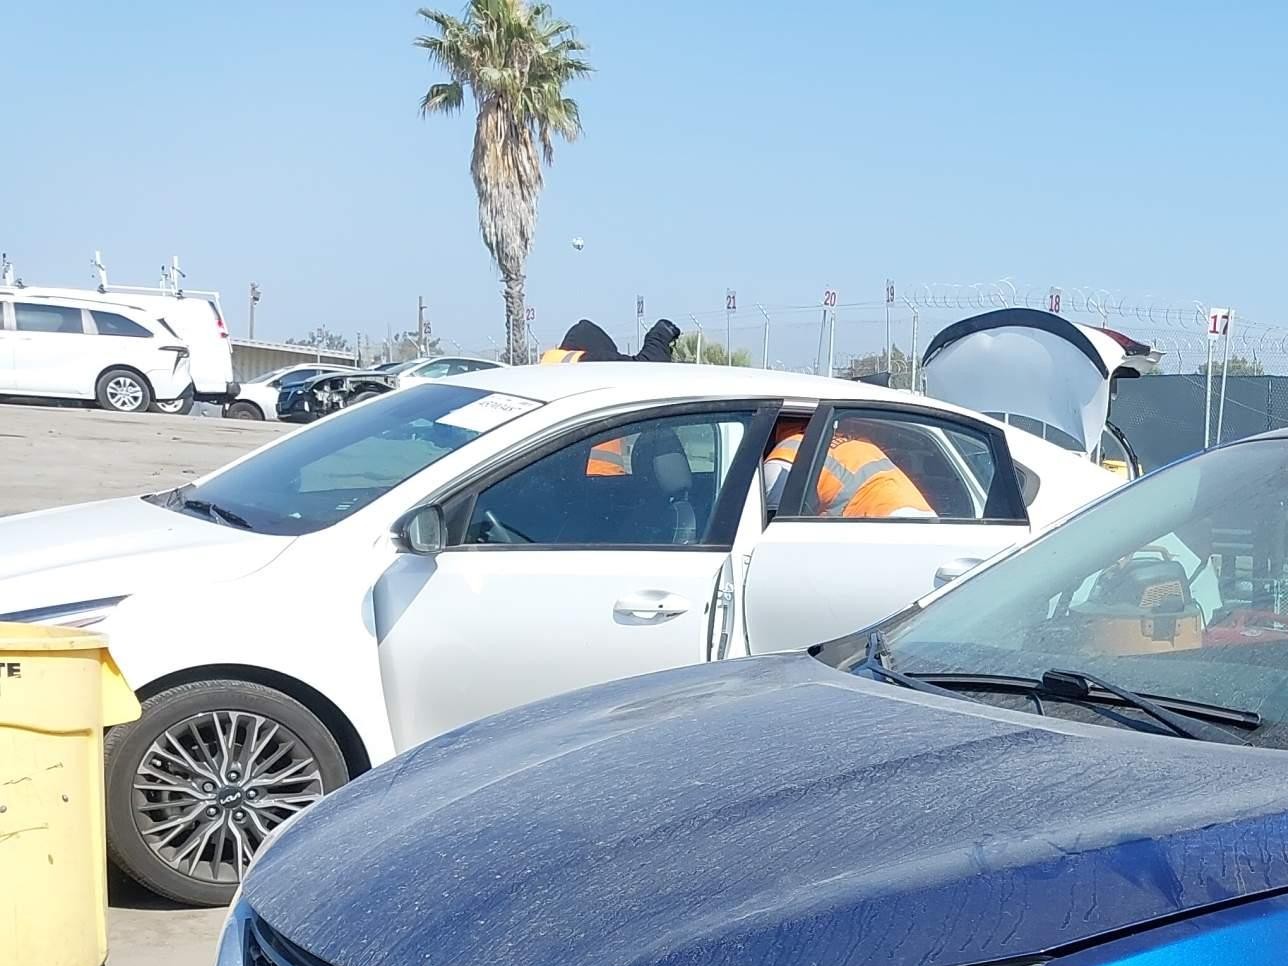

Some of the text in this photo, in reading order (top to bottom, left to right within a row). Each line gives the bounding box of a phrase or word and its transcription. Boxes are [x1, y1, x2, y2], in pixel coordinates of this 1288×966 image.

[726, 295, 737, 310] 21
[823, 290, 837, 307] 20
[1049, 294, 1061, 314] 18
[525, 307, 536, 321] 23
[1208, 314, 1232, 336] 17
